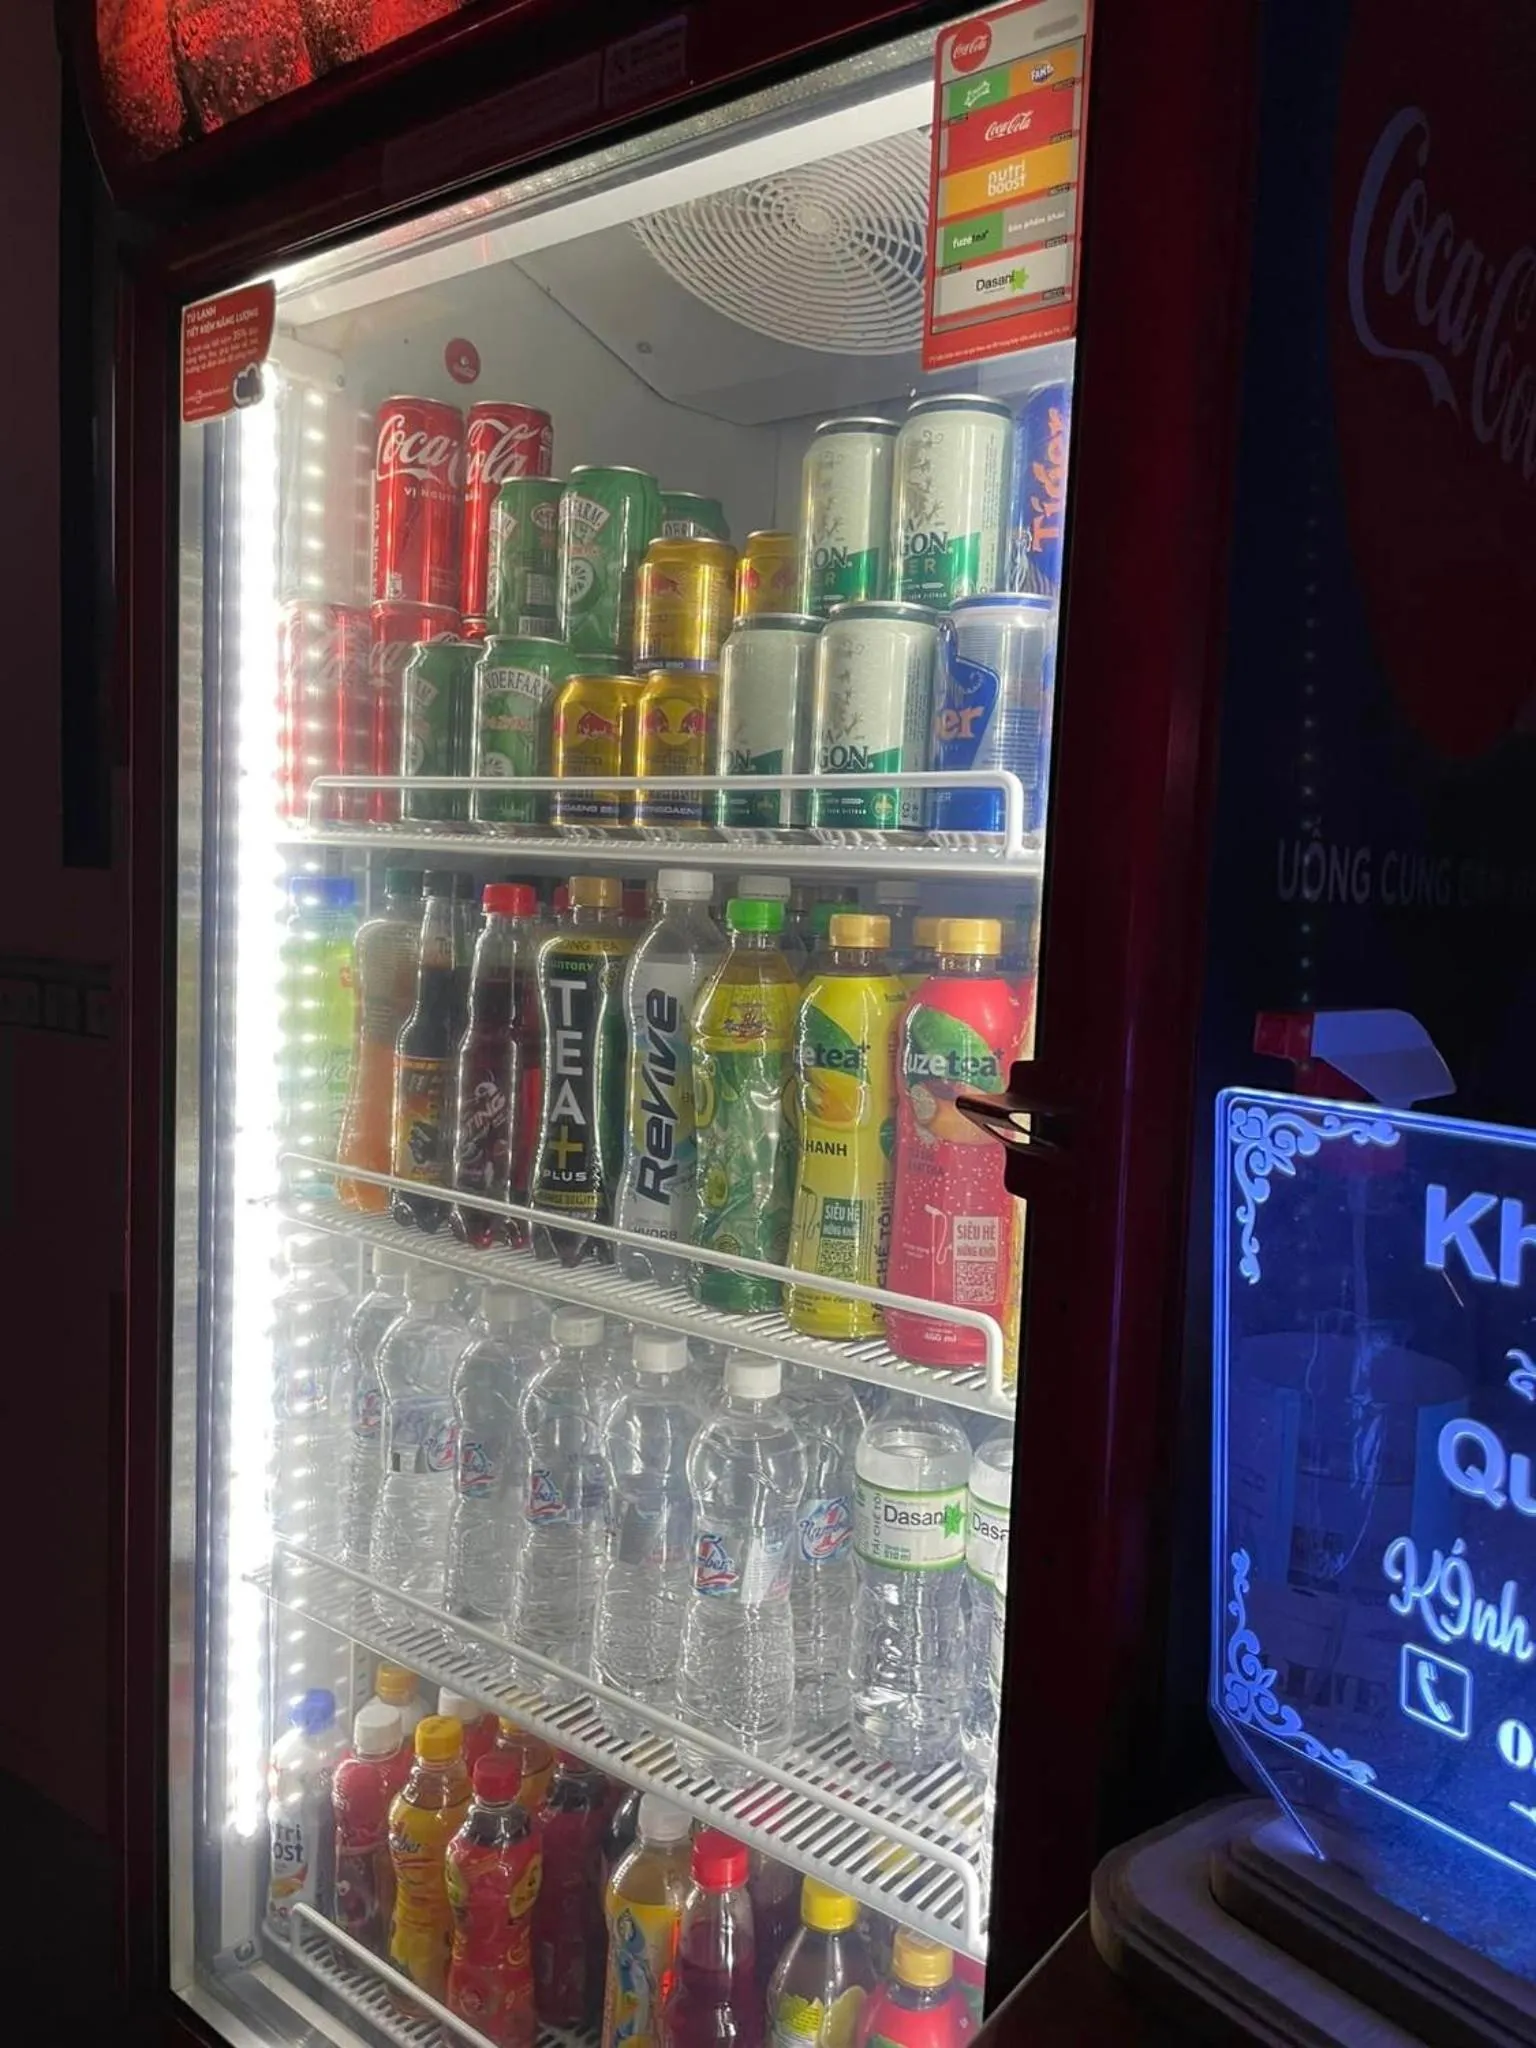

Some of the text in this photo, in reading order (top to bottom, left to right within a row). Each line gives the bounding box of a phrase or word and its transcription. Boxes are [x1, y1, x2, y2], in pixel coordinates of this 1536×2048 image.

[985, 110, 1034, 141] Coca-Cola
[988, 159, 1026, 186] nutri
[988, 175, 1026, 197] boost
[976, 269, 1015, 292] Dasani
[543, 1169, 588, 1182] PLUS
[956, 1220, 980, 1241] SIÊU
[883, 1504, 948, 1526] Dasani
